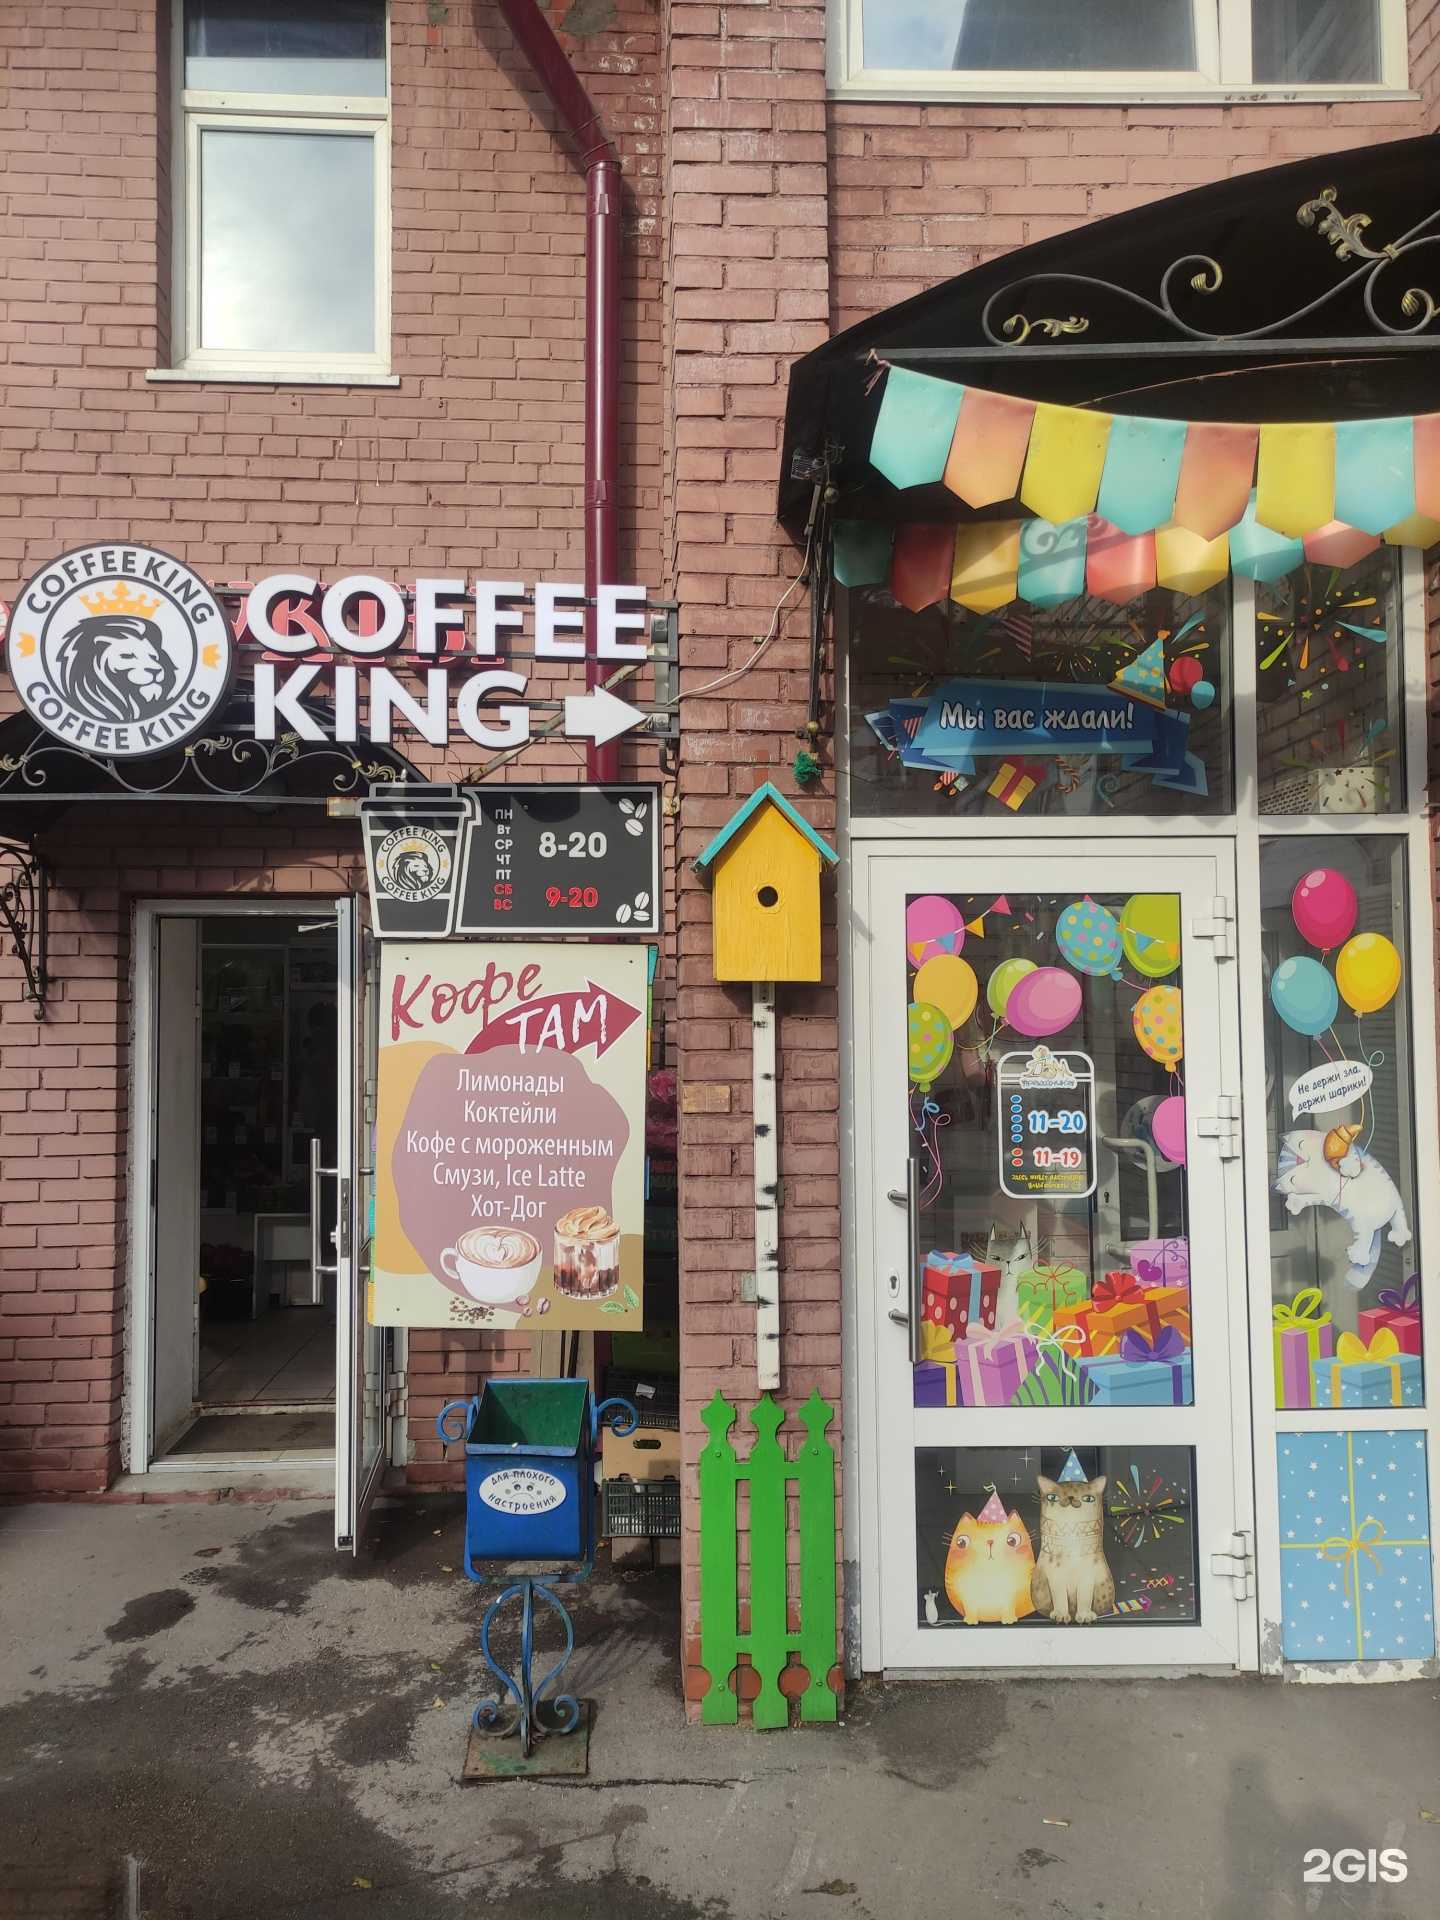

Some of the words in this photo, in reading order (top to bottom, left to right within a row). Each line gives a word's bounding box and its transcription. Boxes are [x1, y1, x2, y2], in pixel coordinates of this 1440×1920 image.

[27, 550, 137, 614] COFFEE
[143, 556, 215, 625] KING
[245, 574, 648, 660] COFFEE
[26, 681, 130, 750] COFFEE
[139, 688, 211, 746] KING
[254, 664, 529, 748] KING
[940, 701, 985, 730] Мы
[993, 708, 1035, 729] вас
[1043, 702, 1134, 730] ждали!
[495, 808, 513, 820] ПН
[381, 827, 419, 853] COFFEE
[420, 828, 446, 853] KING
[494, 839, 513, 850] СР
[539, 831, 607, 858] 8-20
[381, 876, 418, 901] COFFEE
[420, 877, 446, 899] KING
[494, 883, 513, 895] СБ
[545, 886, 599, 908] 9-20
[494, 898, 513, 911] ВС
[391, 961, 543, 1041] Кофе
[505, 994, 608, 1056] ТАМ
[456, 1069, 565, 1093] Лимонады
[1297, 1094, 1327, 1112] держи
[1328, 1075, 1367, 1099] шарики!
[1298, 1083, 1310, 1095] Не
[1312, 1073, 1341, 1090] держи
[463, 1100, 557, 1124] Коктейли
[1028, 1111, 1085, 1133] 11-20
[406, 1130, 456, 1159] Кофе
[461, 1136, 470, 1152] с
[475, 1137, 614, 1157] мороженным
[1033, 1148, 1081, 1167] 11-19
[432, 1163, 500, 1188] Смузи,
[506, 1164, 533, 1187] Ice
[537, 1164, 587, 1188] Latte
[470, 1194, 547, 1221] Хот-Дог
